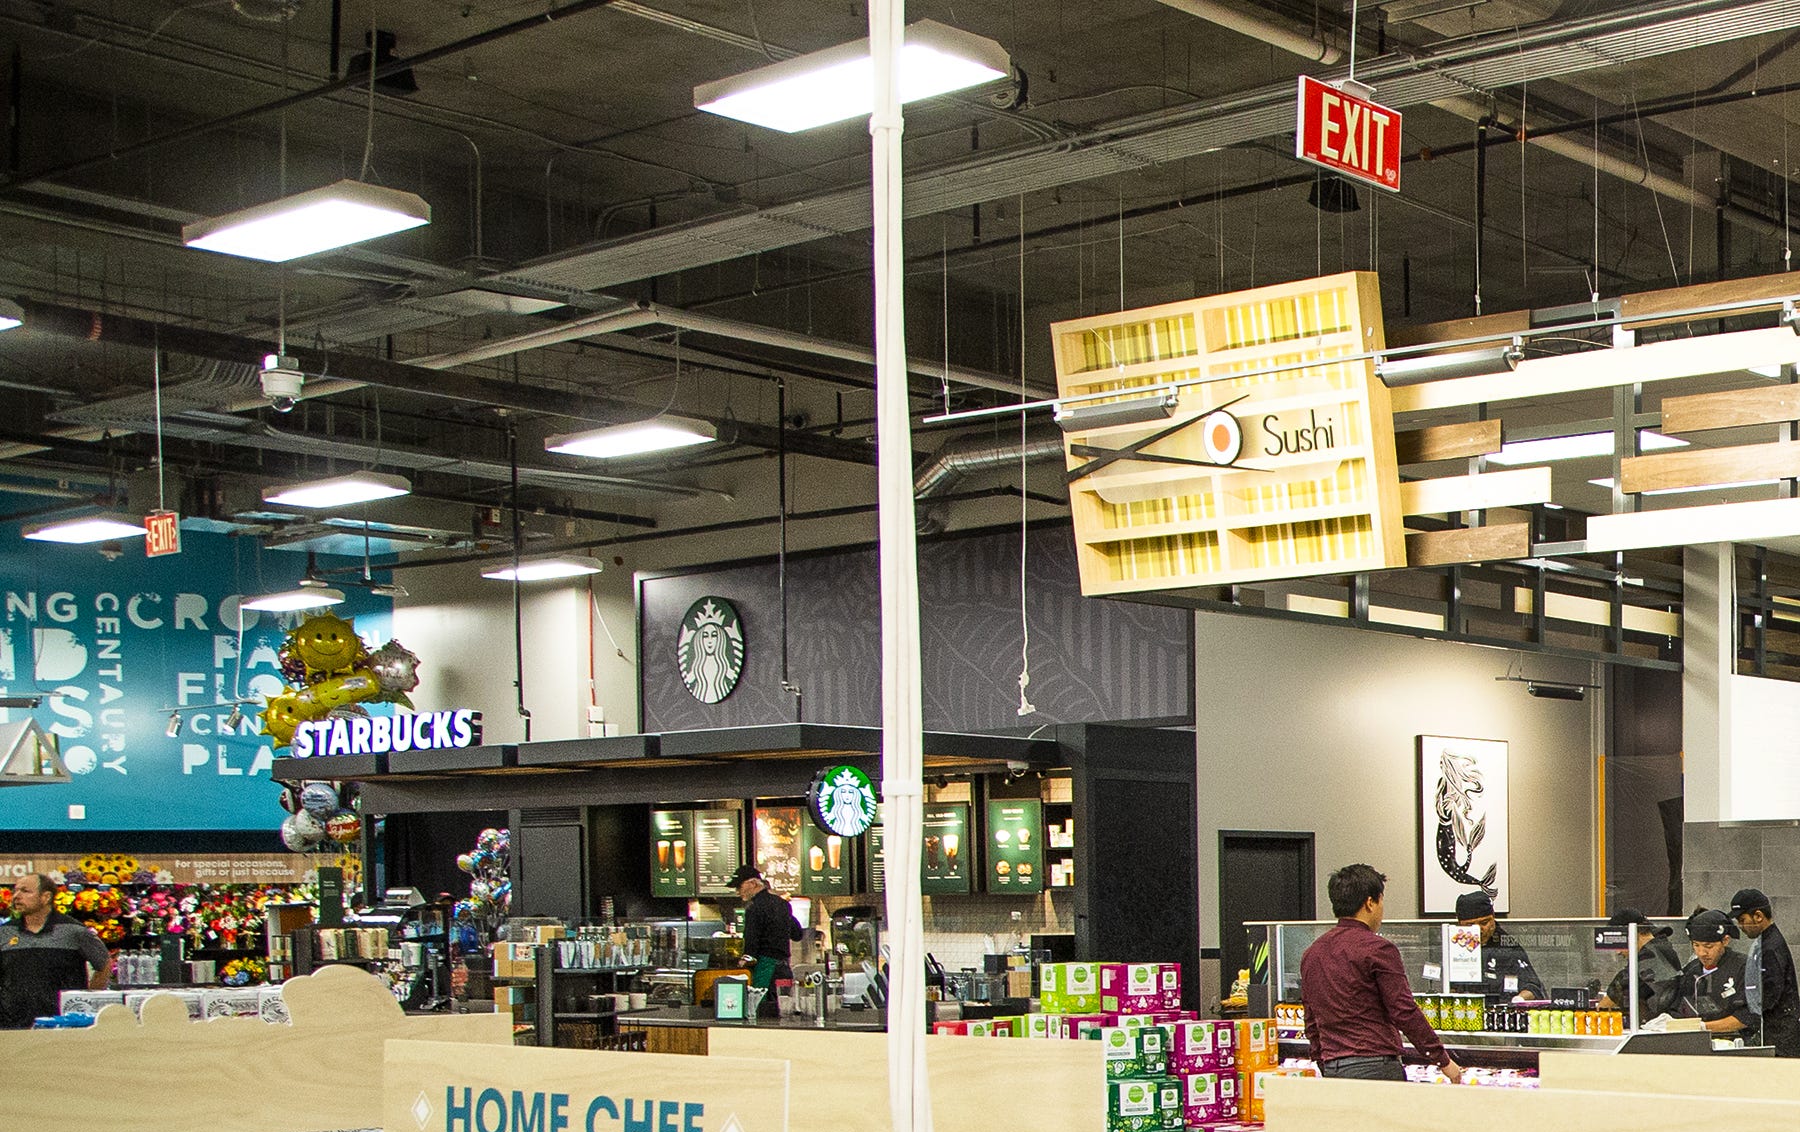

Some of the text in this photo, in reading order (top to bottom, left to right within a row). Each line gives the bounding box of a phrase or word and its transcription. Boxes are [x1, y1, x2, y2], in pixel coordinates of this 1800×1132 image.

[1321, 91, 1390, 177] EXIT
[1263, 414, 1336, 457] Sushi
[151, 517, 174, 553] EXIT
[96, 592, 128, 776] CENTAURY
[297, 708, 474, 759] STARBUCKS
[174, 859, 287, 871] For special occasions,
[195, 868, 295, 880] gifts or just because
